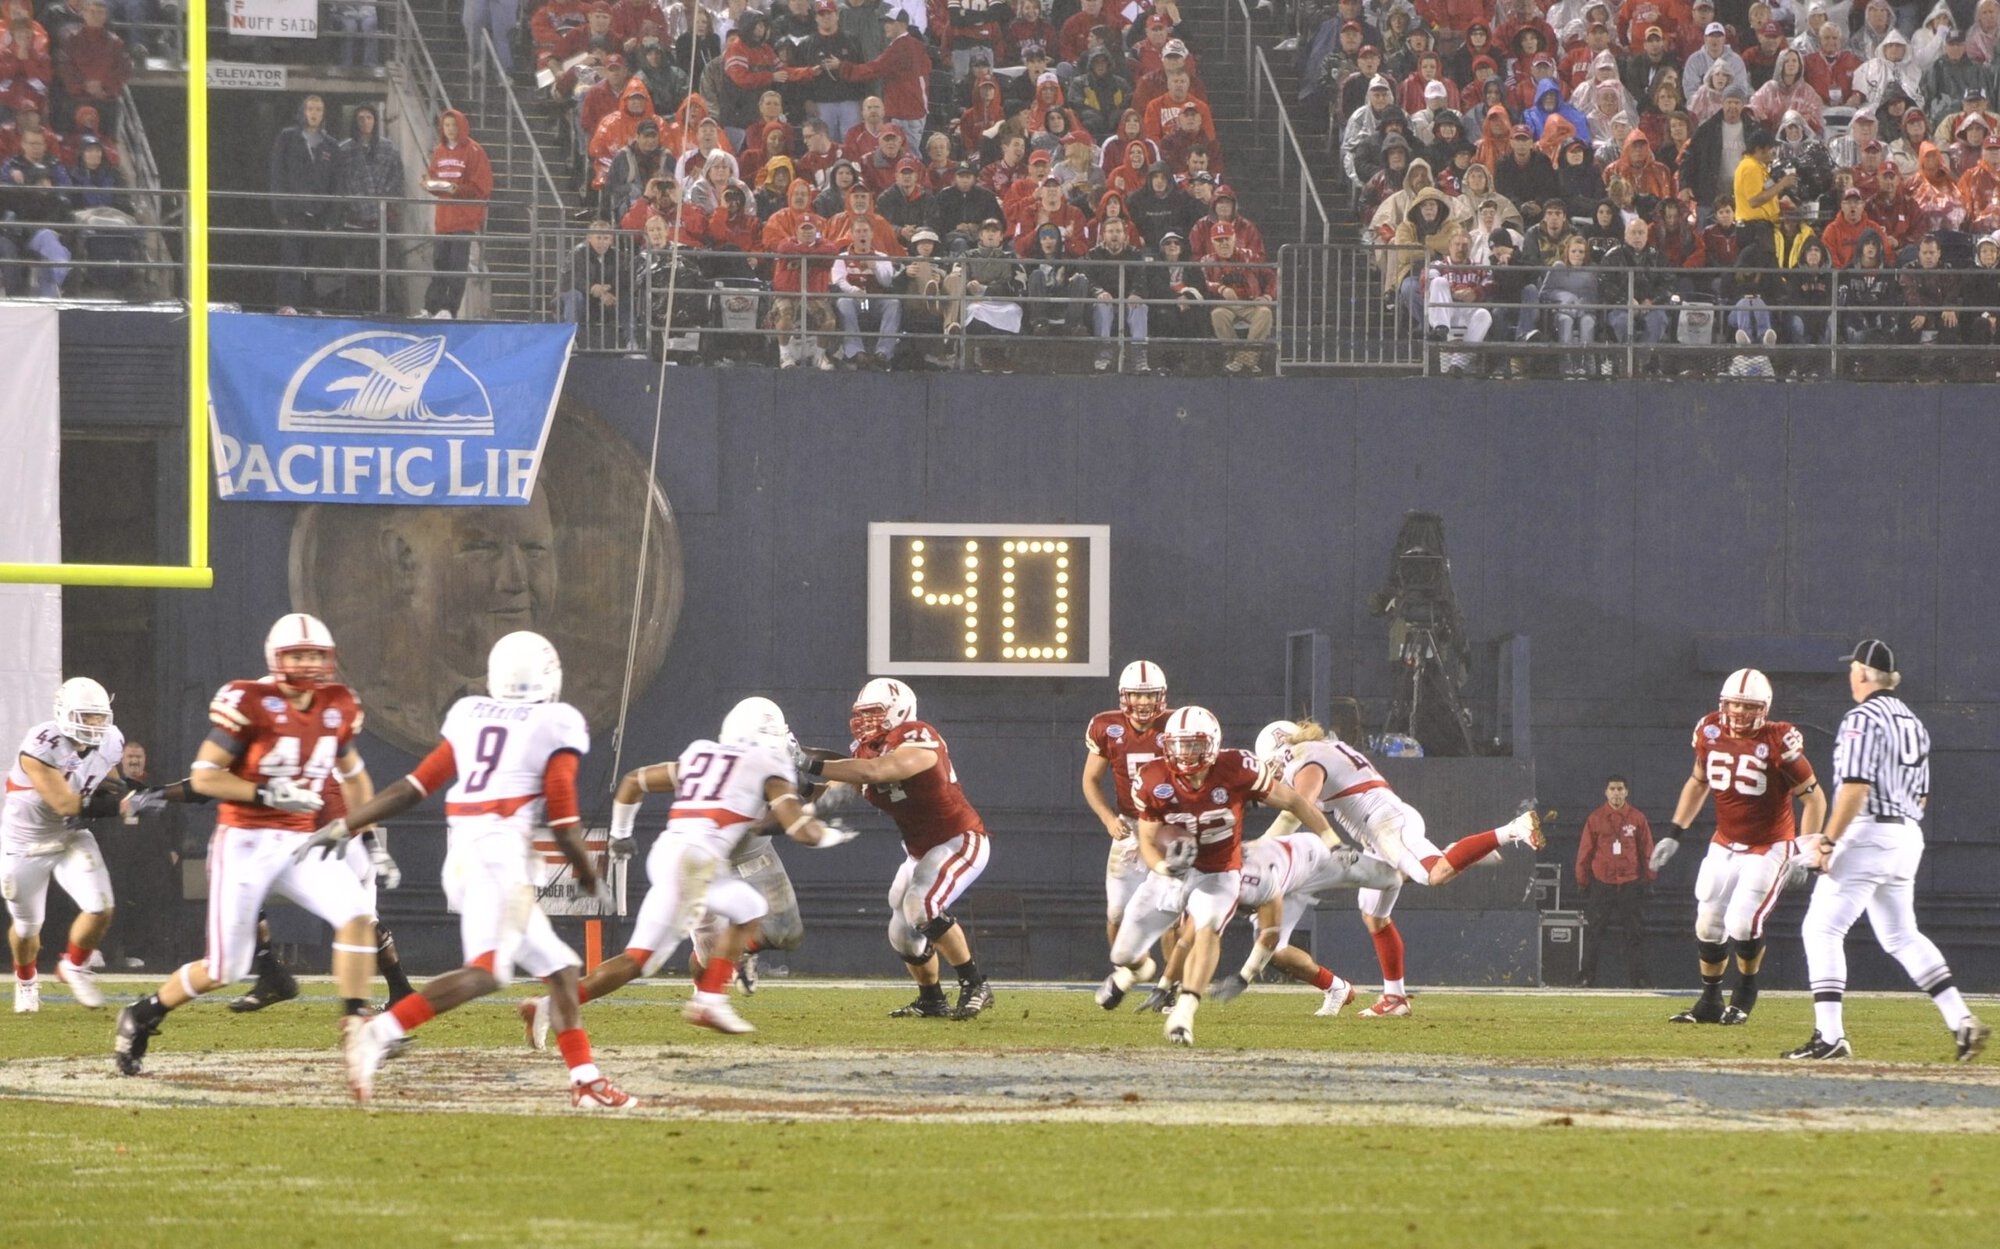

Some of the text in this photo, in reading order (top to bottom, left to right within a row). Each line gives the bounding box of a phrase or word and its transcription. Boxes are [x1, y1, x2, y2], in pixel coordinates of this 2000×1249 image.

[232, 15, 317, 33] NUFF SAID
[215, 68, 283, 80] ELEVATOR
[240, 80, 281, 88] PLAZA
[217, 434, 437, 497] PACIFIC
[911, 540, 1069, 659] 40
[888, 683, 900, 697] N
[36, 729, 62, 750] 44
[464, 725, 509, 794] 9
[258, 735, 339, 793] 44
[678, 752, 740, 801] 21
[1706, 750, 1768, 796] 65
